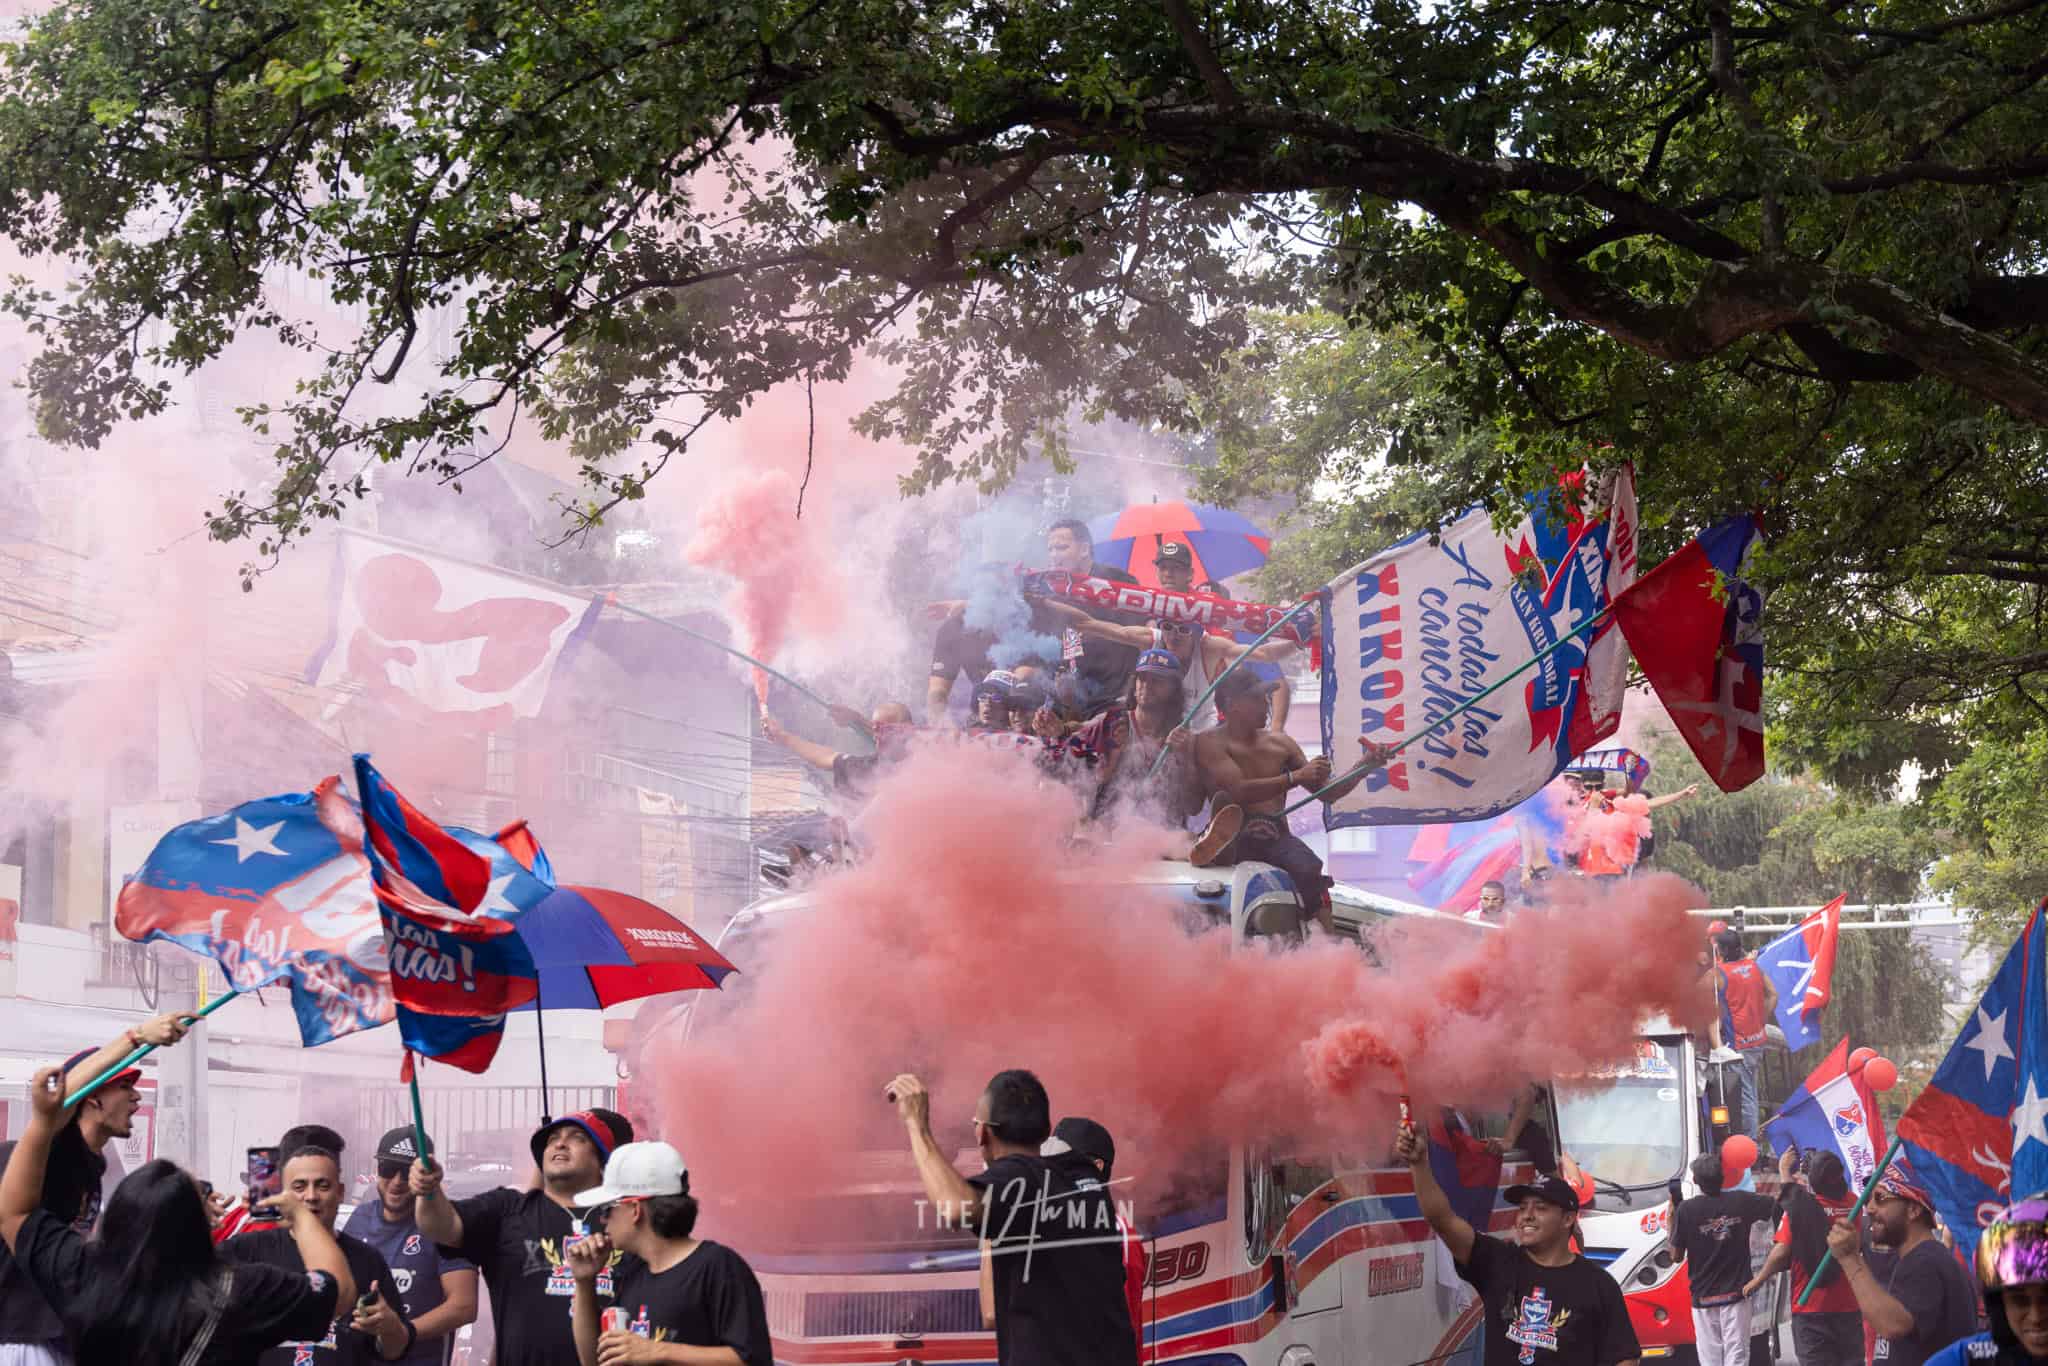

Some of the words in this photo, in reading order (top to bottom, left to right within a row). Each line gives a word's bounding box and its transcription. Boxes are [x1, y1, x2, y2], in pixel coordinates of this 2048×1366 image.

[1441, 541, 1493, 591] A
[1116, 587, 1214, 624] DIM
[1455, 602, 1500, 694] todas
[1461, 705, 1502, 759] las
